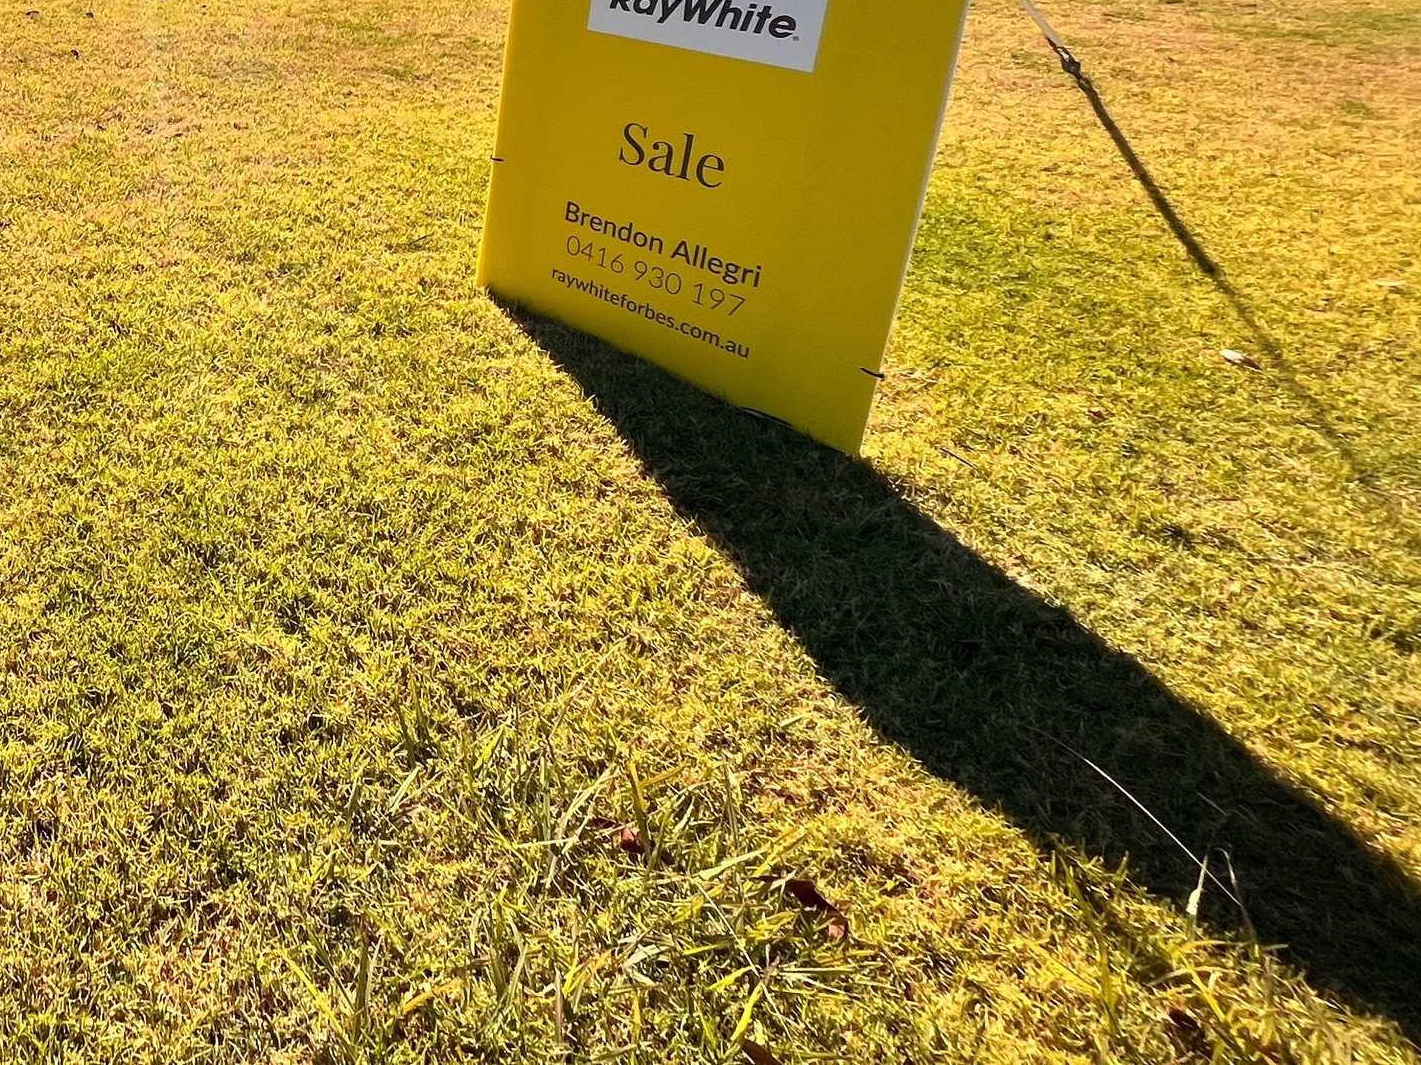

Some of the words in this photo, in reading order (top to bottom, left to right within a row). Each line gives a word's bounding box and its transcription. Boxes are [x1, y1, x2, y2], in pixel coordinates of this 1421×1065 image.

[618, 122, 726, 190] Sale
[564, 200, 664, 255] Brendon
[670, 239, 763, 289] Allegri
[565, 234, 625, 276] 0416
[633, 260, 683, 296] 930
[691, 284, 747, 317] 197
[551, 265, 750, 359] raywhiteforbes.com.au
